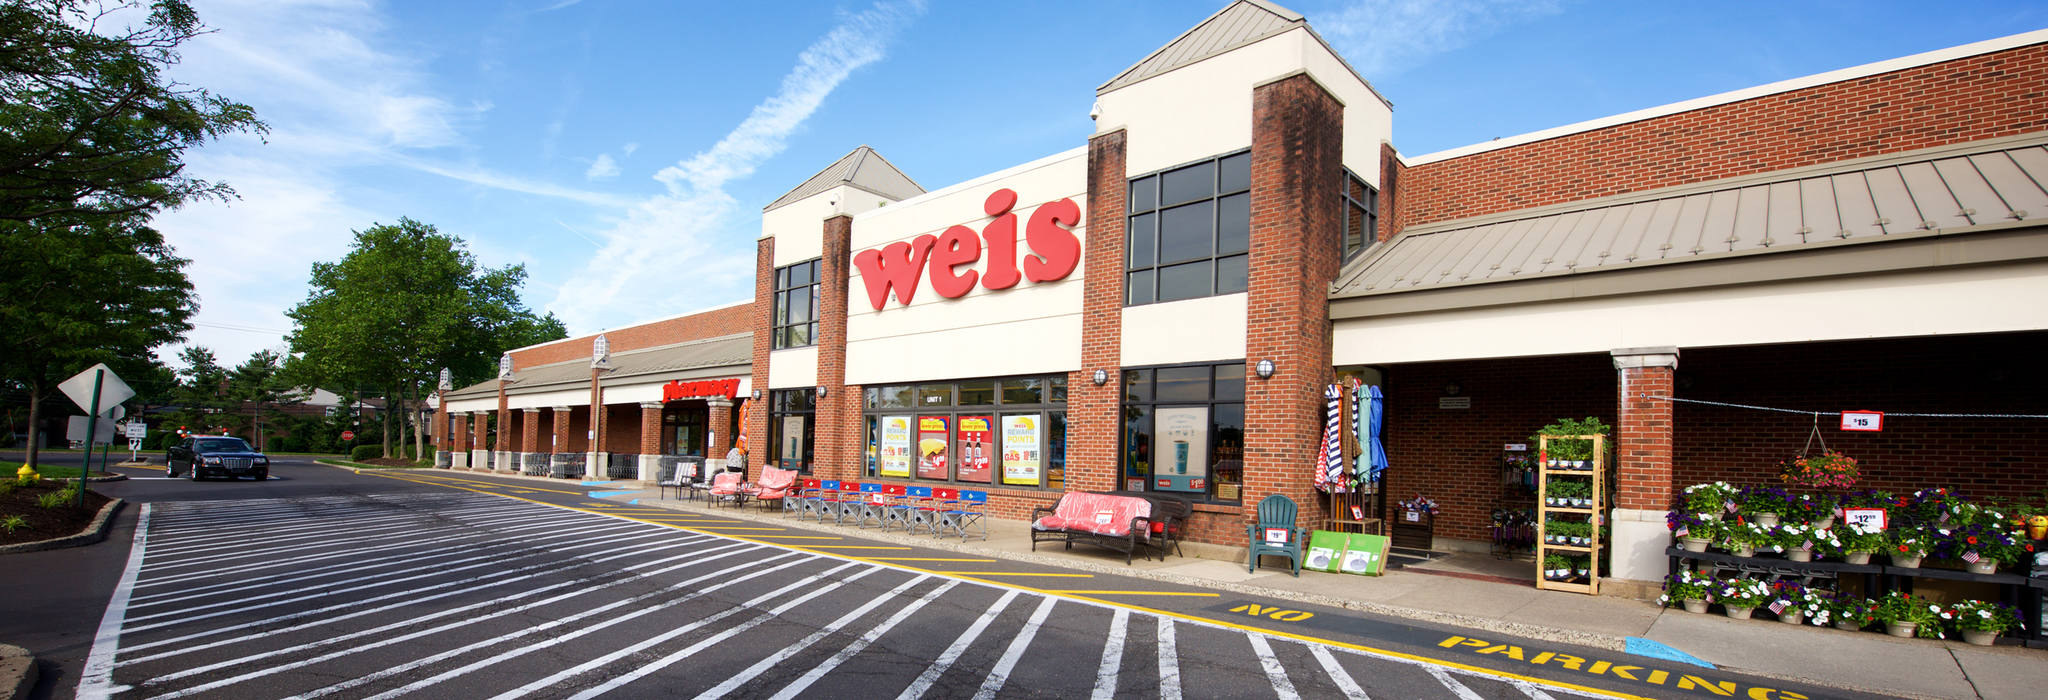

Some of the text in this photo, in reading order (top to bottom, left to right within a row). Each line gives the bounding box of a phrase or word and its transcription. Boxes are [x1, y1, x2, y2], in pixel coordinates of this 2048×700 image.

[854, 188, 1081, 311] weis
[662, 379, 741, 403] pharmacy
[1854, 418, 1868, 426] $15
[1004, 453, 1020, 461] GAS
[1228, 603, 1315, 621] NO
[1437, 635, 1809, 700] PARKING
